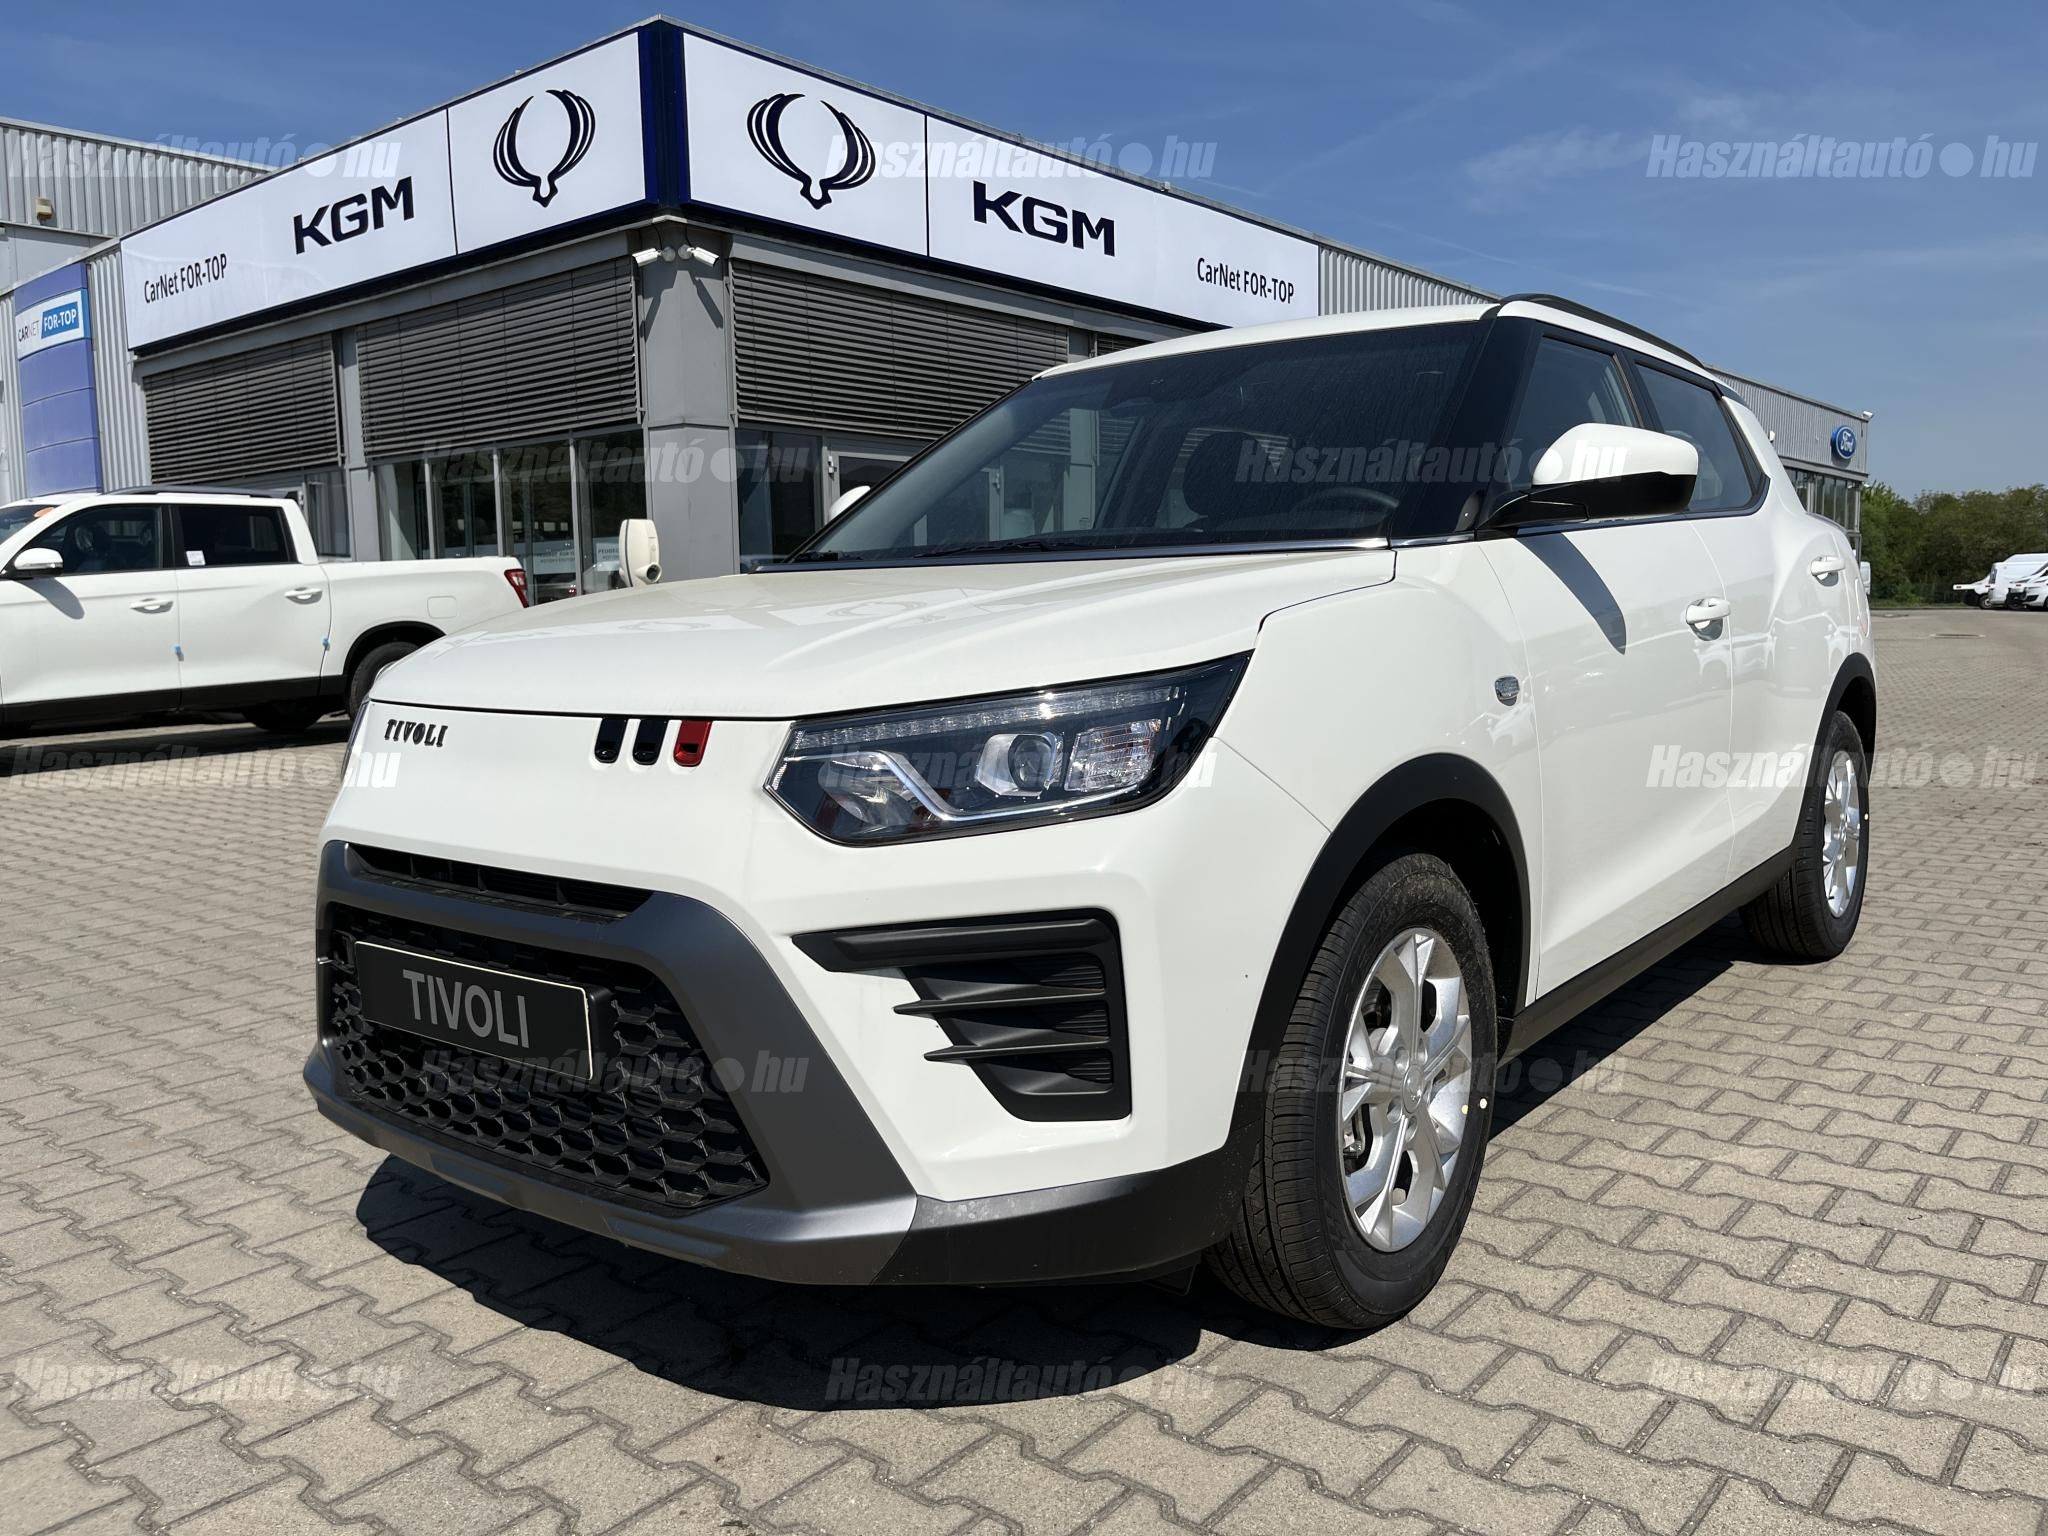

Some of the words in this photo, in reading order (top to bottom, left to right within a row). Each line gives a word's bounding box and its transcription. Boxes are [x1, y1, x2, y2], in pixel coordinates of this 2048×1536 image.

[293, 176, 414, 255] KGM
[973, 180, 1115, 257] KGM
[144, 272, 179, 304] CarNet
[180, 253, 228, 292] FOR-TOP
[1197, 257, 1241, 292] CarNet
[1243, 270, 1294, 304] FOR-TOP
[44, 307, 78, 332] FOR-TOP
[1840, 430, 1855, 453] Ford
[384, 718, 448, 748] TIVOLI
[402, 968, 530, 1049] TIVOLI
